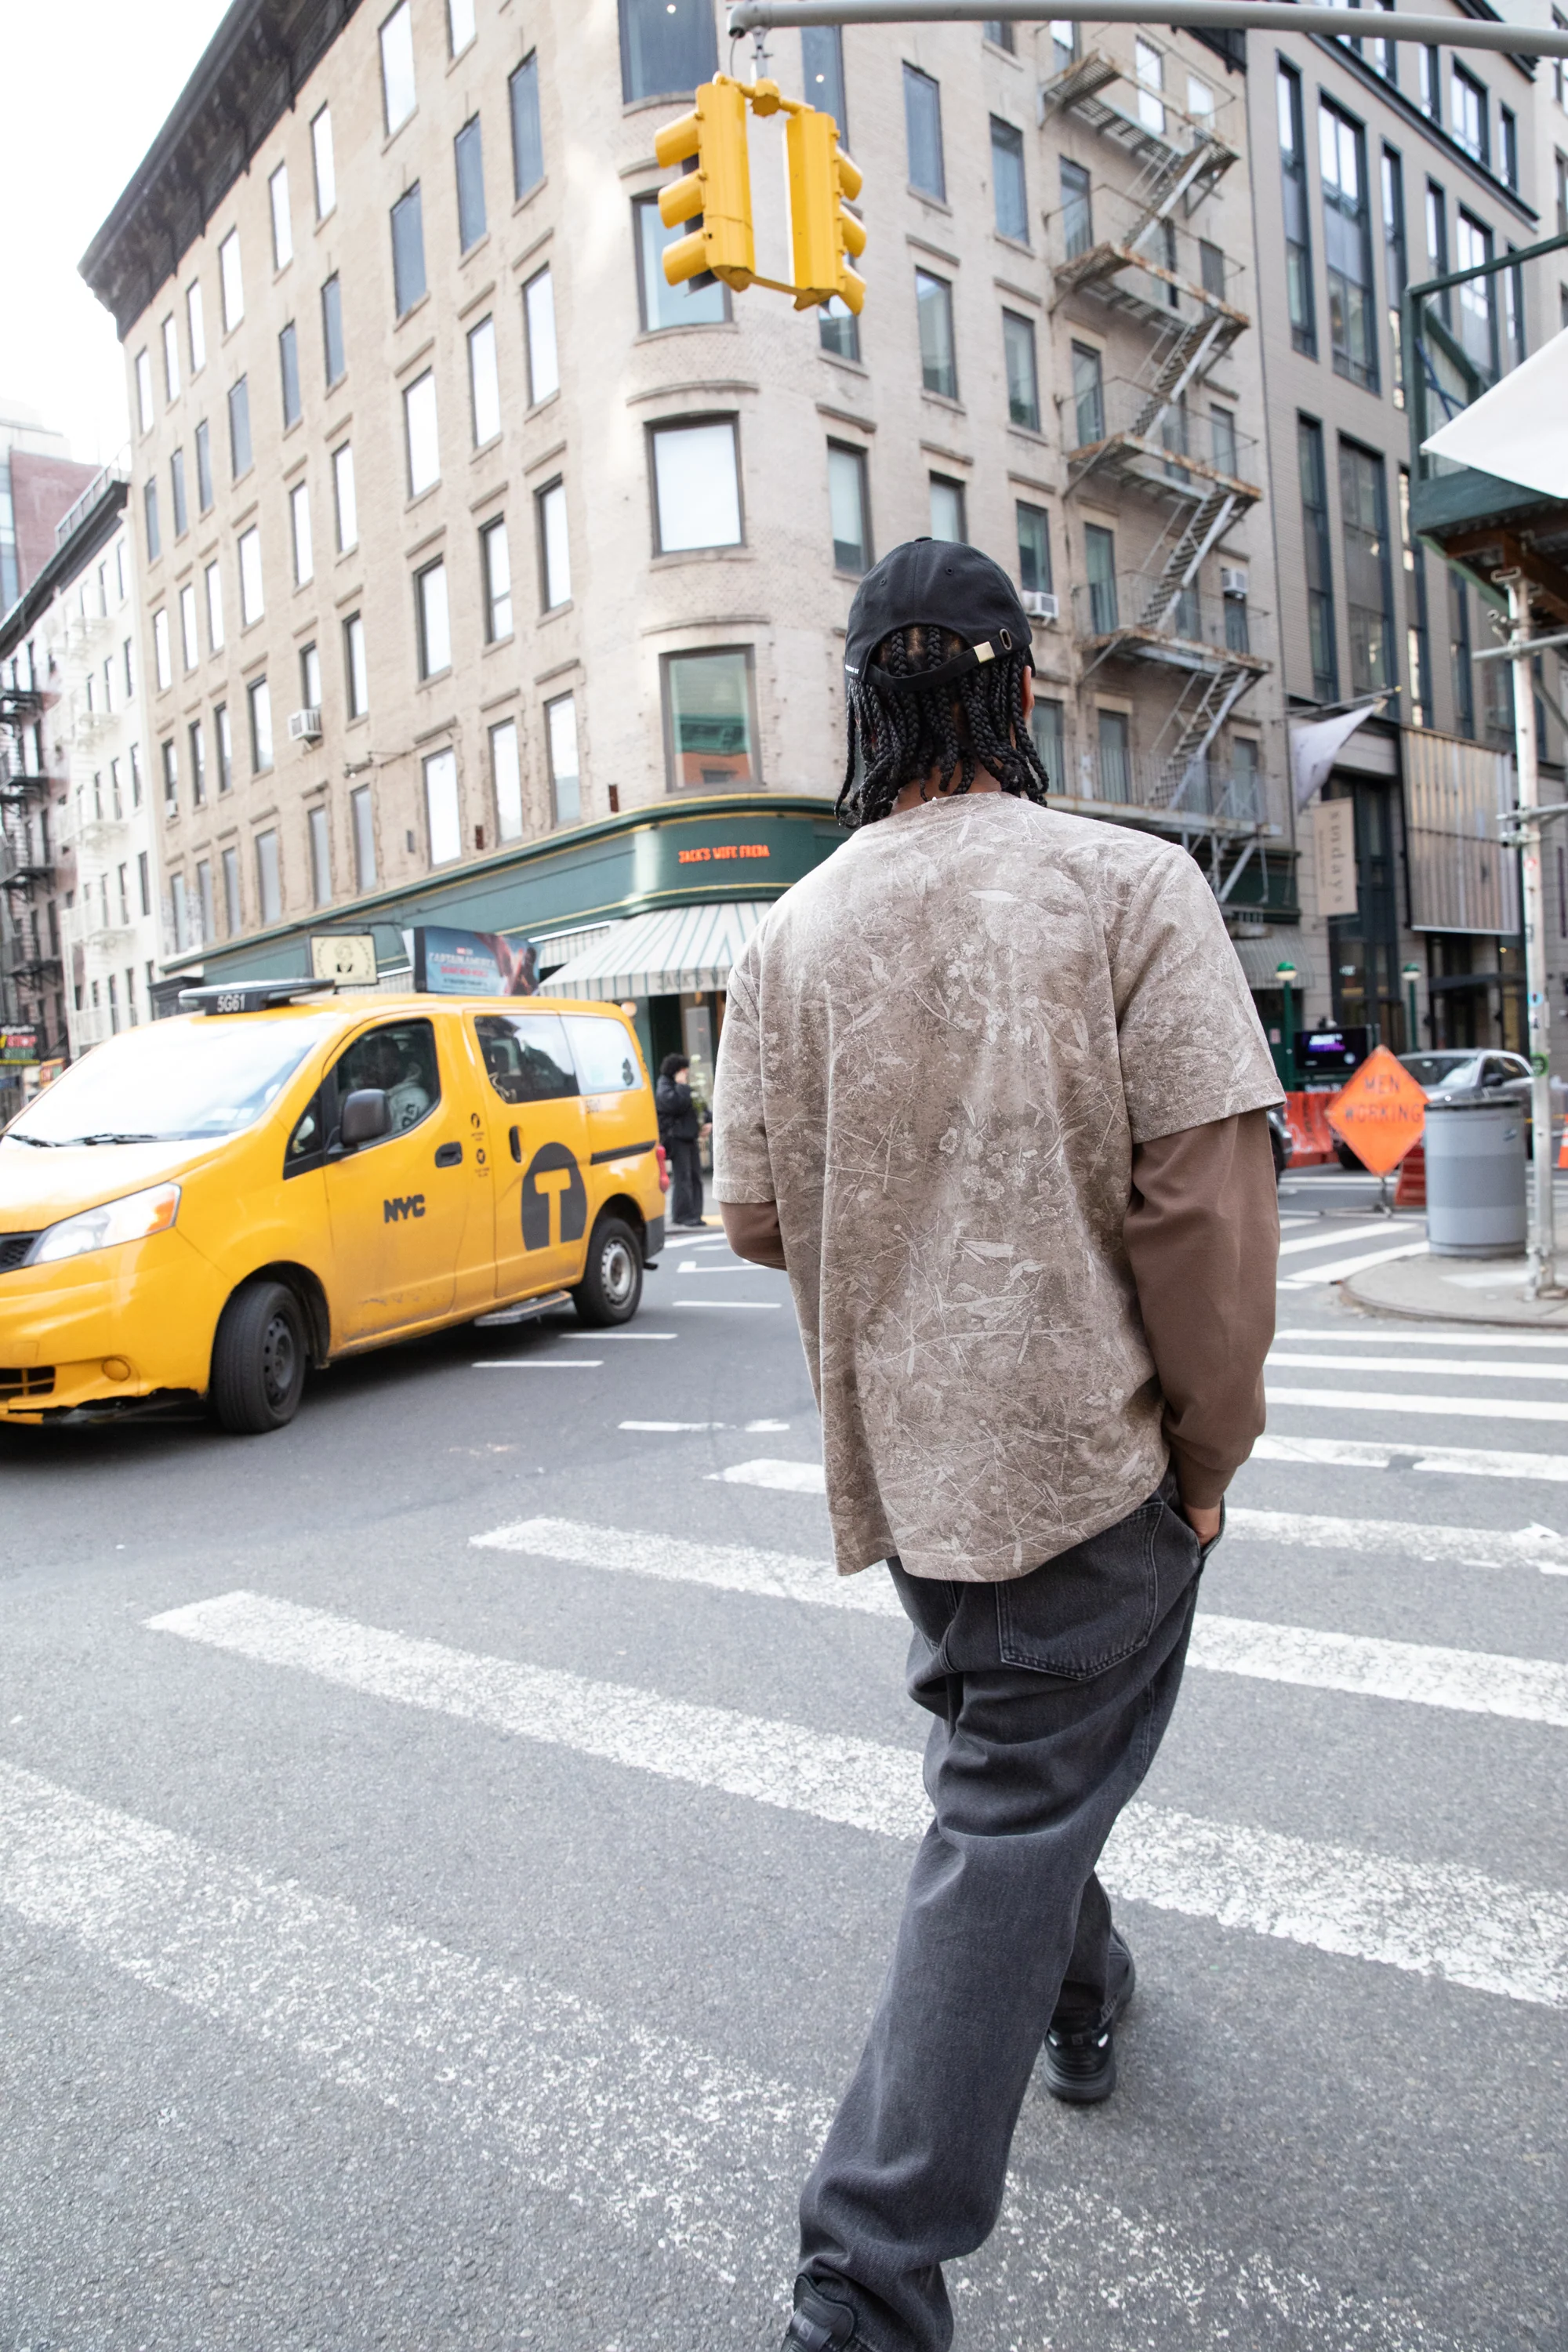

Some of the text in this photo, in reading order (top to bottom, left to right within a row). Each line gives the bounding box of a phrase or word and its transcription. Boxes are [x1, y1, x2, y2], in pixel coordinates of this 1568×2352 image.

[678, 847, 711, 863] JACK'S
[216, 993, 246, 1013] 5G61
[1364, 1074, 1401, 1094] MEN
[1345, 1103, 1422, 1123] WORKING
[383, 1194, 426, 1224] NYC
